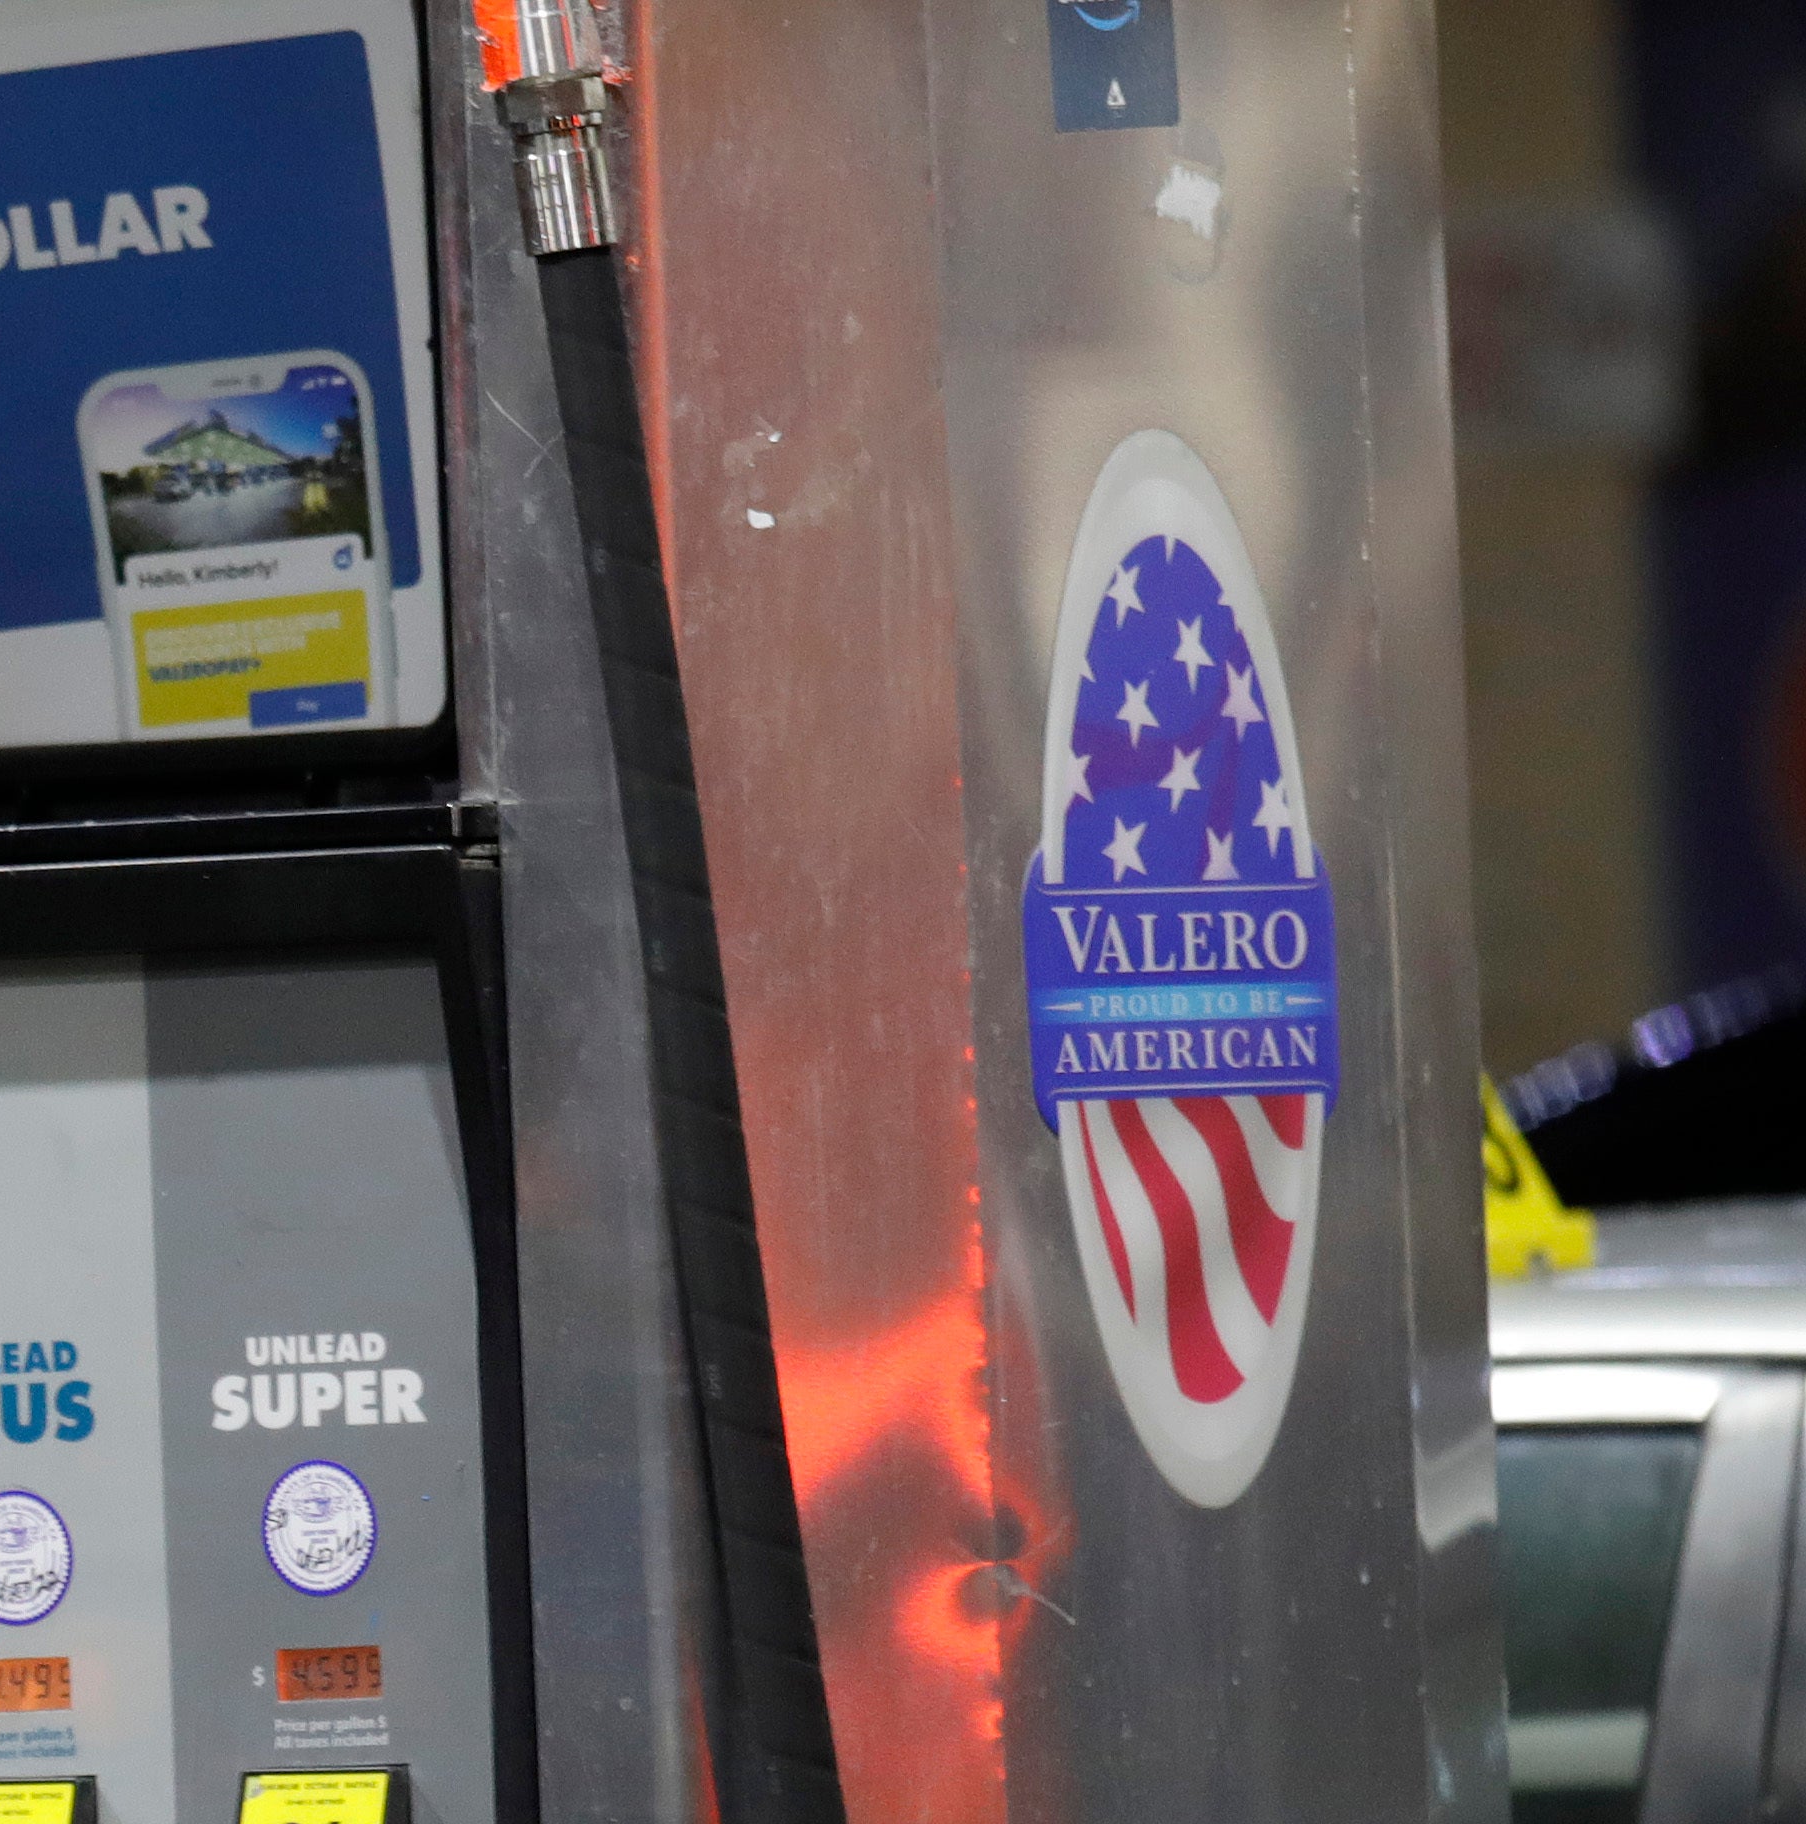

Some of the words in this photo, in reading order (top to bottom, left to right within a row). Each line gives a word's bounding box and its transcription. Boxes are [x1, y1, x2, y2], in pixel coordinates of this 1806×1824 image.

[1050, 905, 1309, 974] VALERO
[1089, 992, 1188, 1018] PROUD
[1201, 990, 1238, 1015] TO
[1249, 989, 1285, 1014] BE
[1054, 1024, 1318, 1074] AMERICAN
[244, 1331, 387, 1367] UNLEAD
[211, 1368, 429, 1432] SUPER
[250, 1664, 266, 1688] $
[274, 1716, 307, 1733] Price
[308, 1717, 332, 1733] per
[333, 1713, 376, 1733] gallon
[331, 1731, 389, 1747] included
